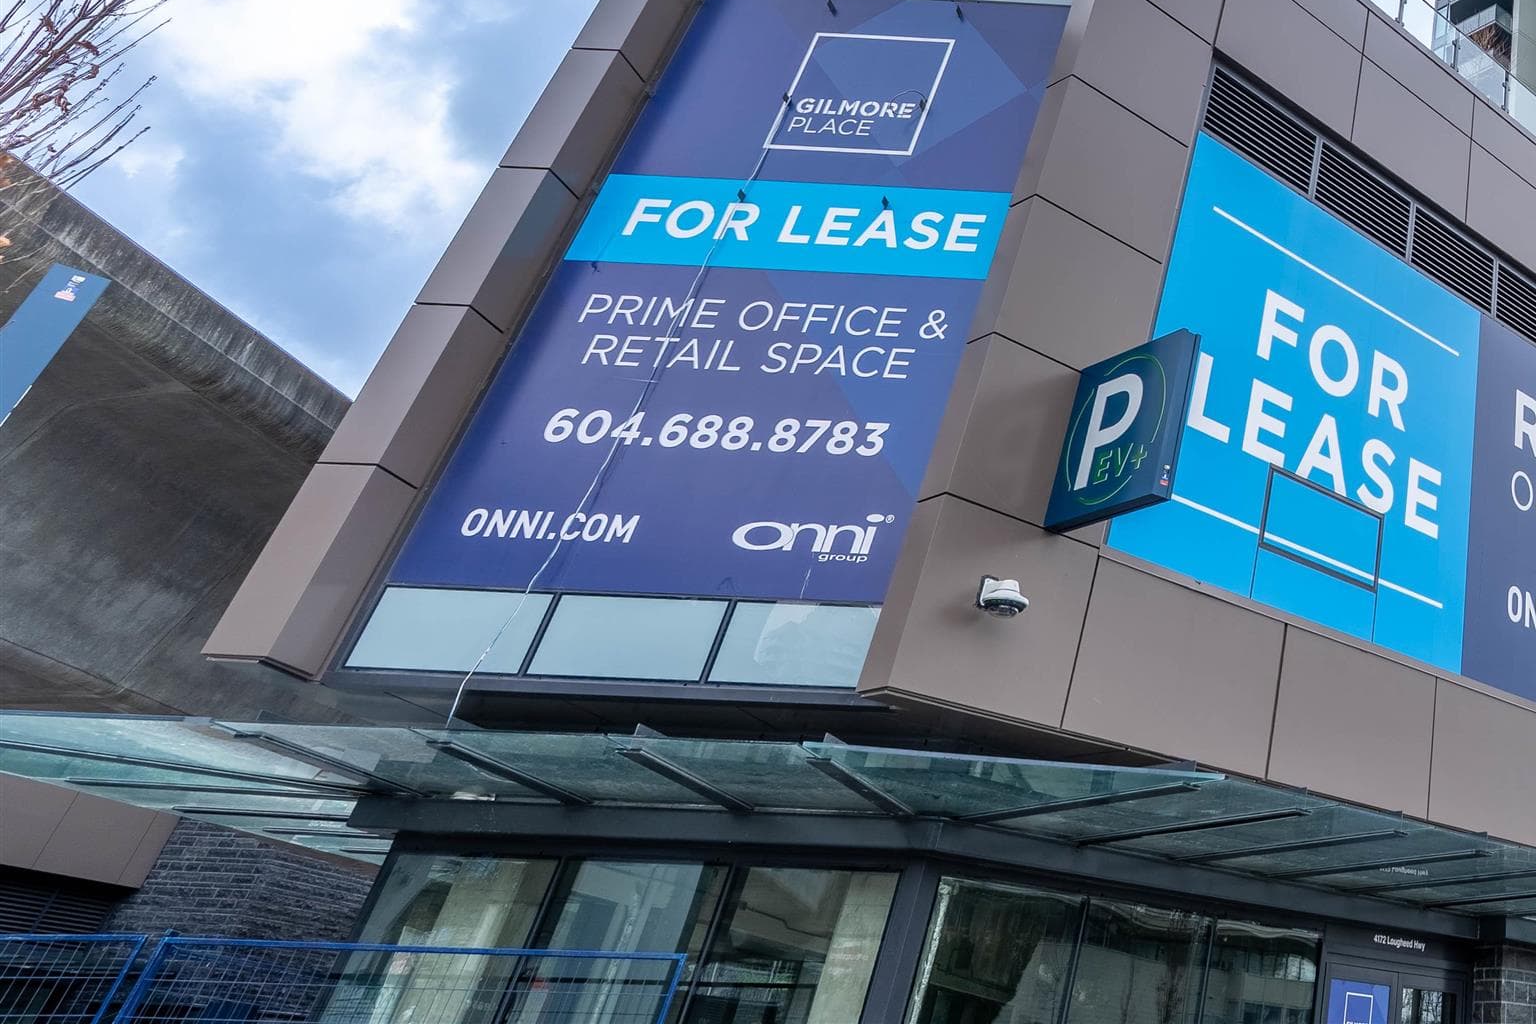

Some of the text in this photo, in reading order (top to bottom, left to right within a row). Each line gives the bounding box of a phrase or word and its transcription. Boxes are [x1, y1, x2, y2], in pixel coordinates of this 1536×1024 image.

[787, 116, 875, 136] PLACE
[795, 97, 916, 119] GILMORE
[622, 198, 987, 252] FOR LEASE
[577, 293, 948, 340] PRIME OFFICE &
[581, 334, 916, 379] RETAIL SPACE
[1256, 288, 1409, 433] FOR
[543, 408, 891, 457] 604.688.8783
[1073, 373, 1144, 491] P
[1186, 351, 1442, 540] LEASE
[461, 507, 641, 543] ONNI.COM
[818, 553, 868, 564] group
[1373, 934, 1386, 945] 4172
